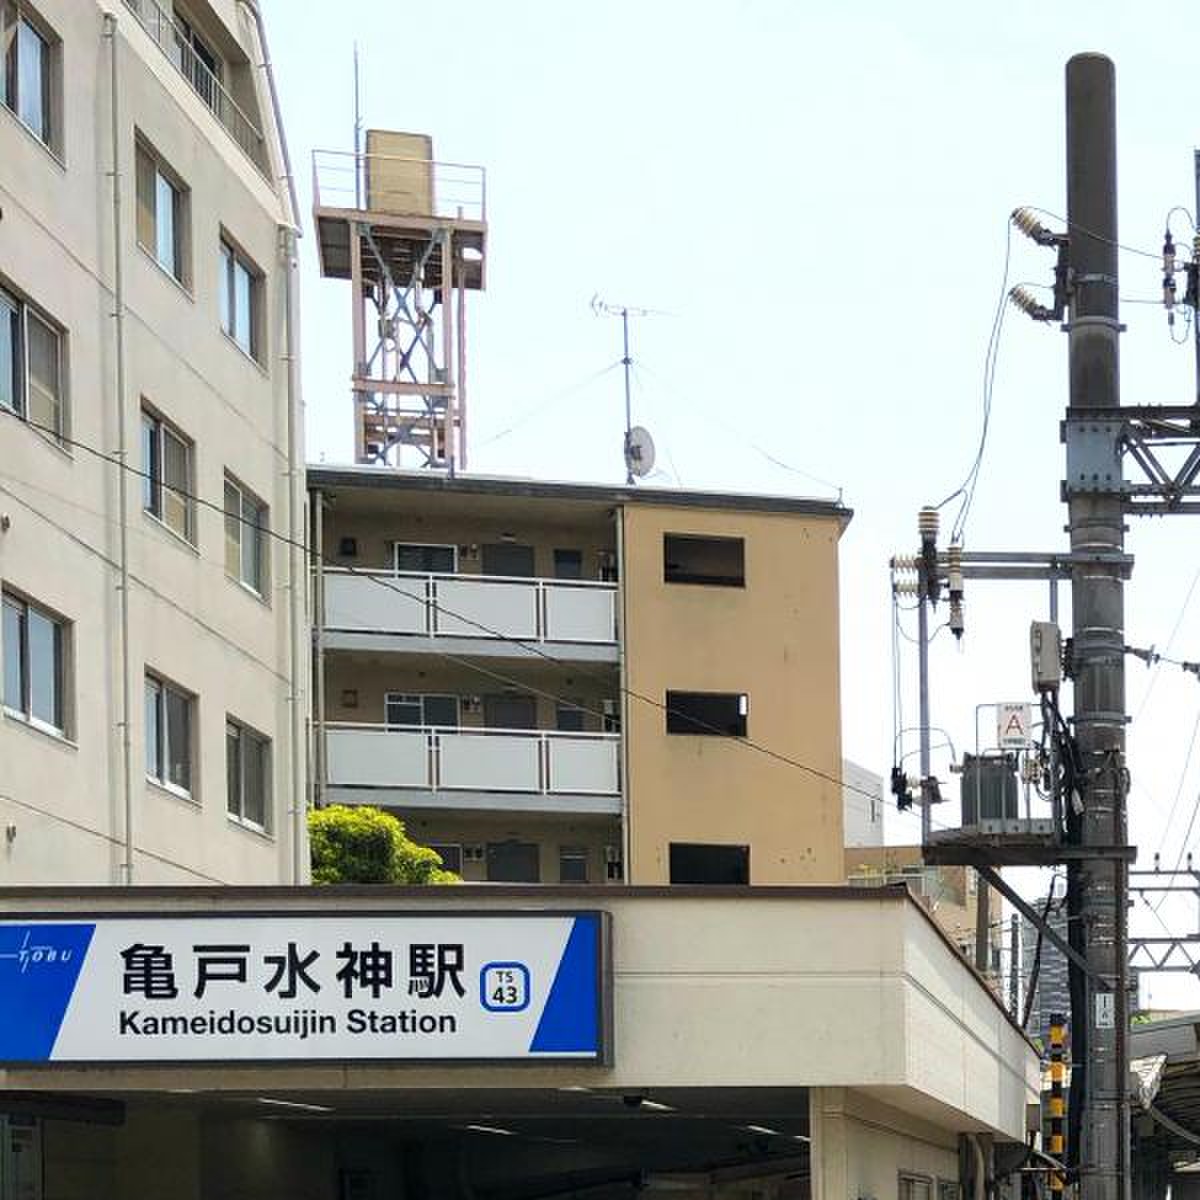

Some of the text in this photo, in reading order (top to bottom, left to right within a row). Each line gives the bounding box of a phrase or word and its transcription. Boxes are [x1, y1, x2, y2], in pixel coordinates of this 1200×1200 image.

[119, 941, 466, 1000] 亀戸水神駅
[495, 970, 513, 983] TS
[492, 986, 517, 1004] 43
[119, 1008, 457, 1040] Kameidosuijin Station
